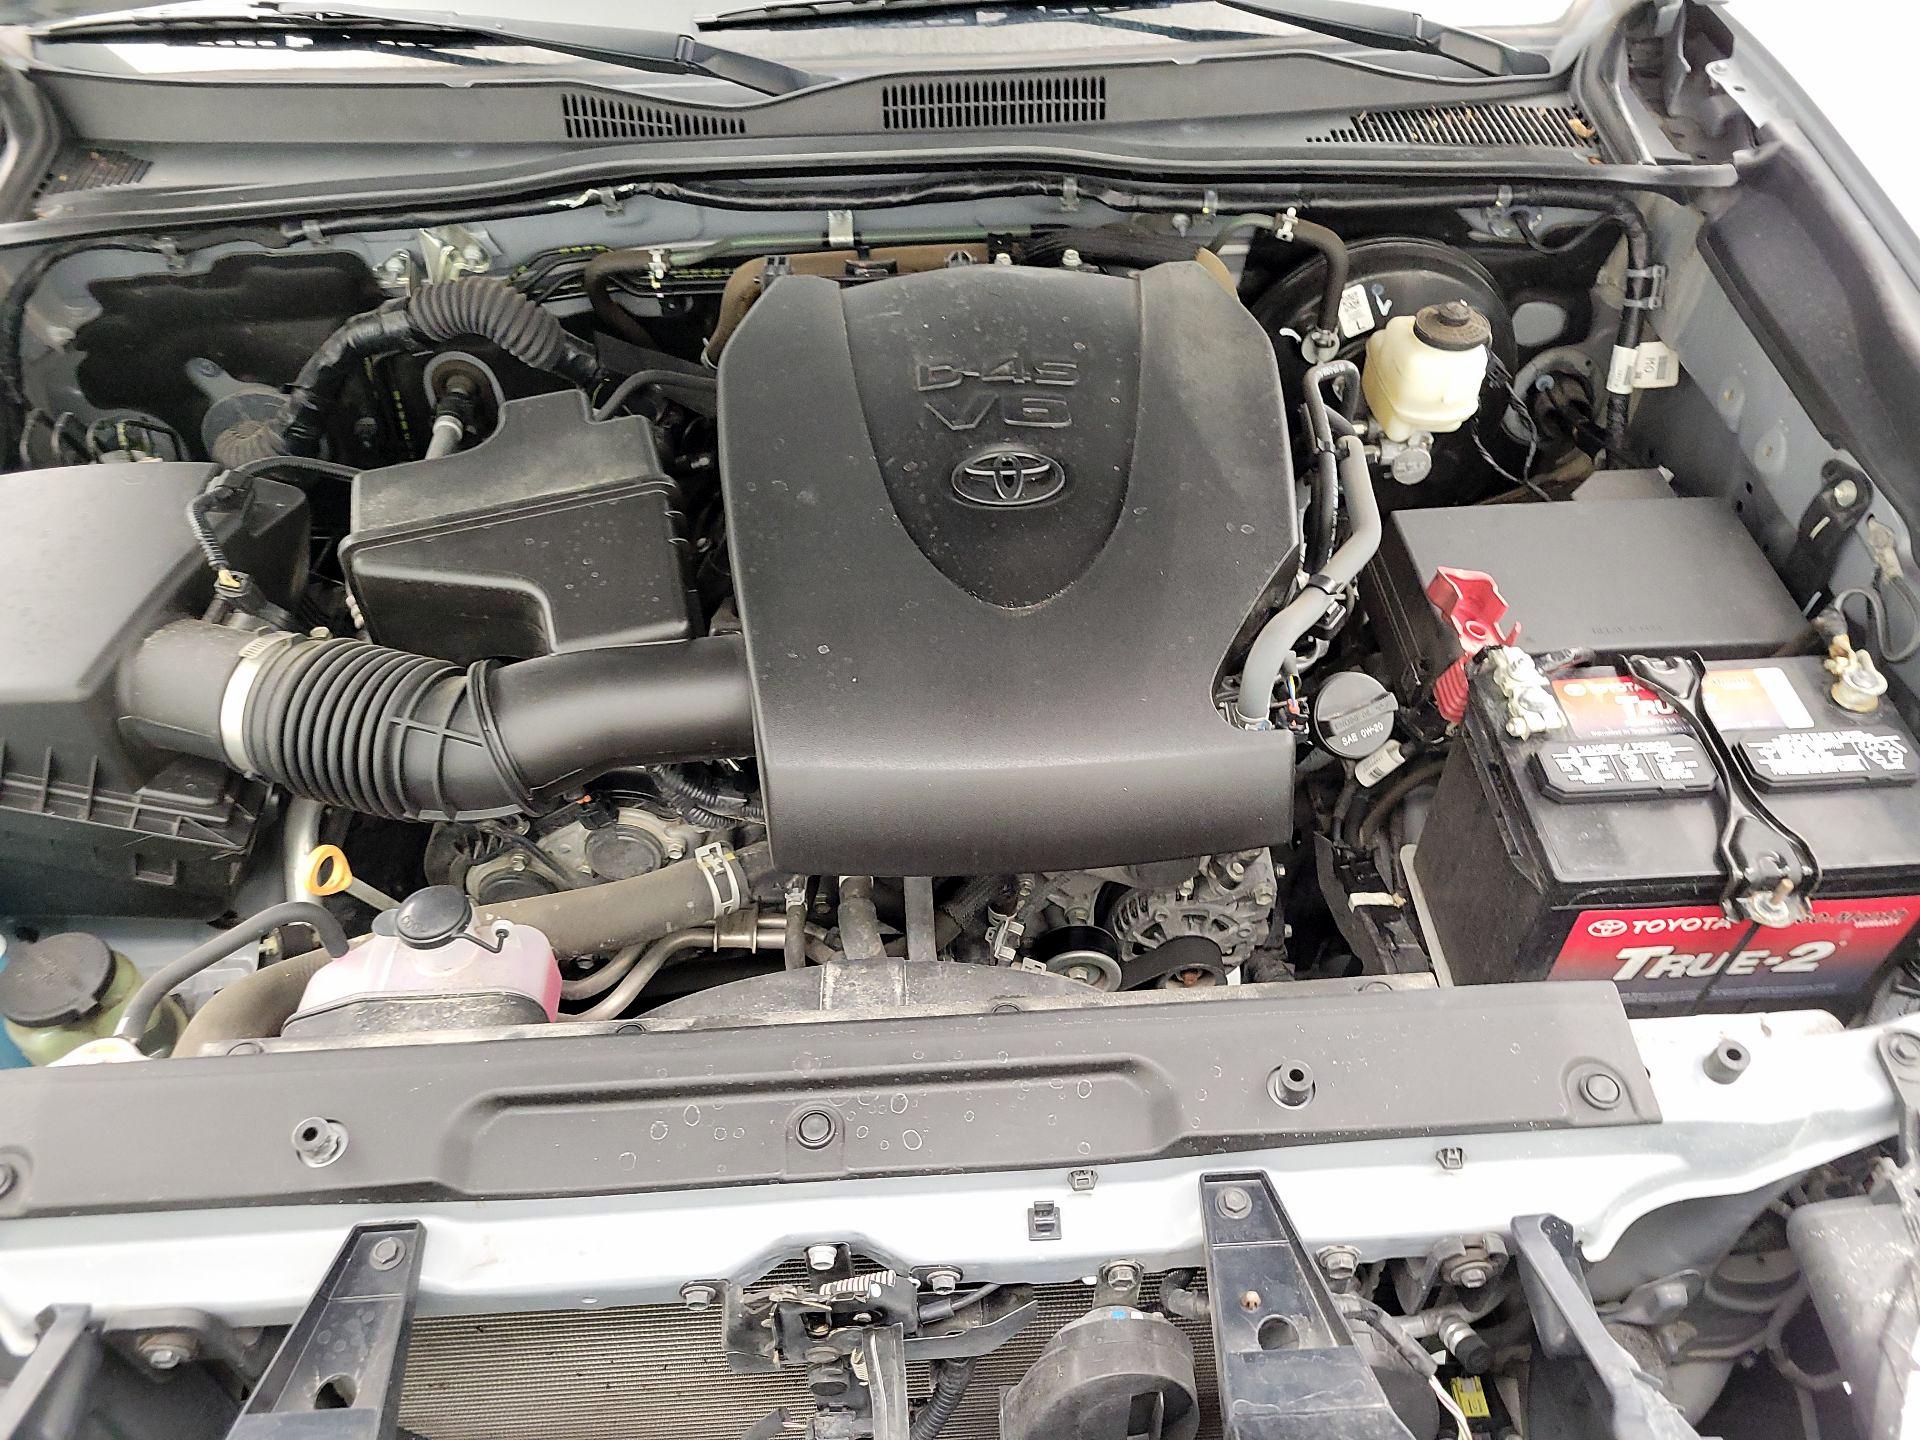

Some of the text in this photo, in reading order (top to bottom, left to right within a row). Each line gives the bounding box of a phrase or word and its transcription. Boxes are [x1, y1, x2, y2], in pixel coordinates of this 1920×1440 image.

[923, 391, 1074, 431] V6
[1632, 917, 1732, 935] TOYOTA
[1612, 941, 1836, 981] TRUE-2
